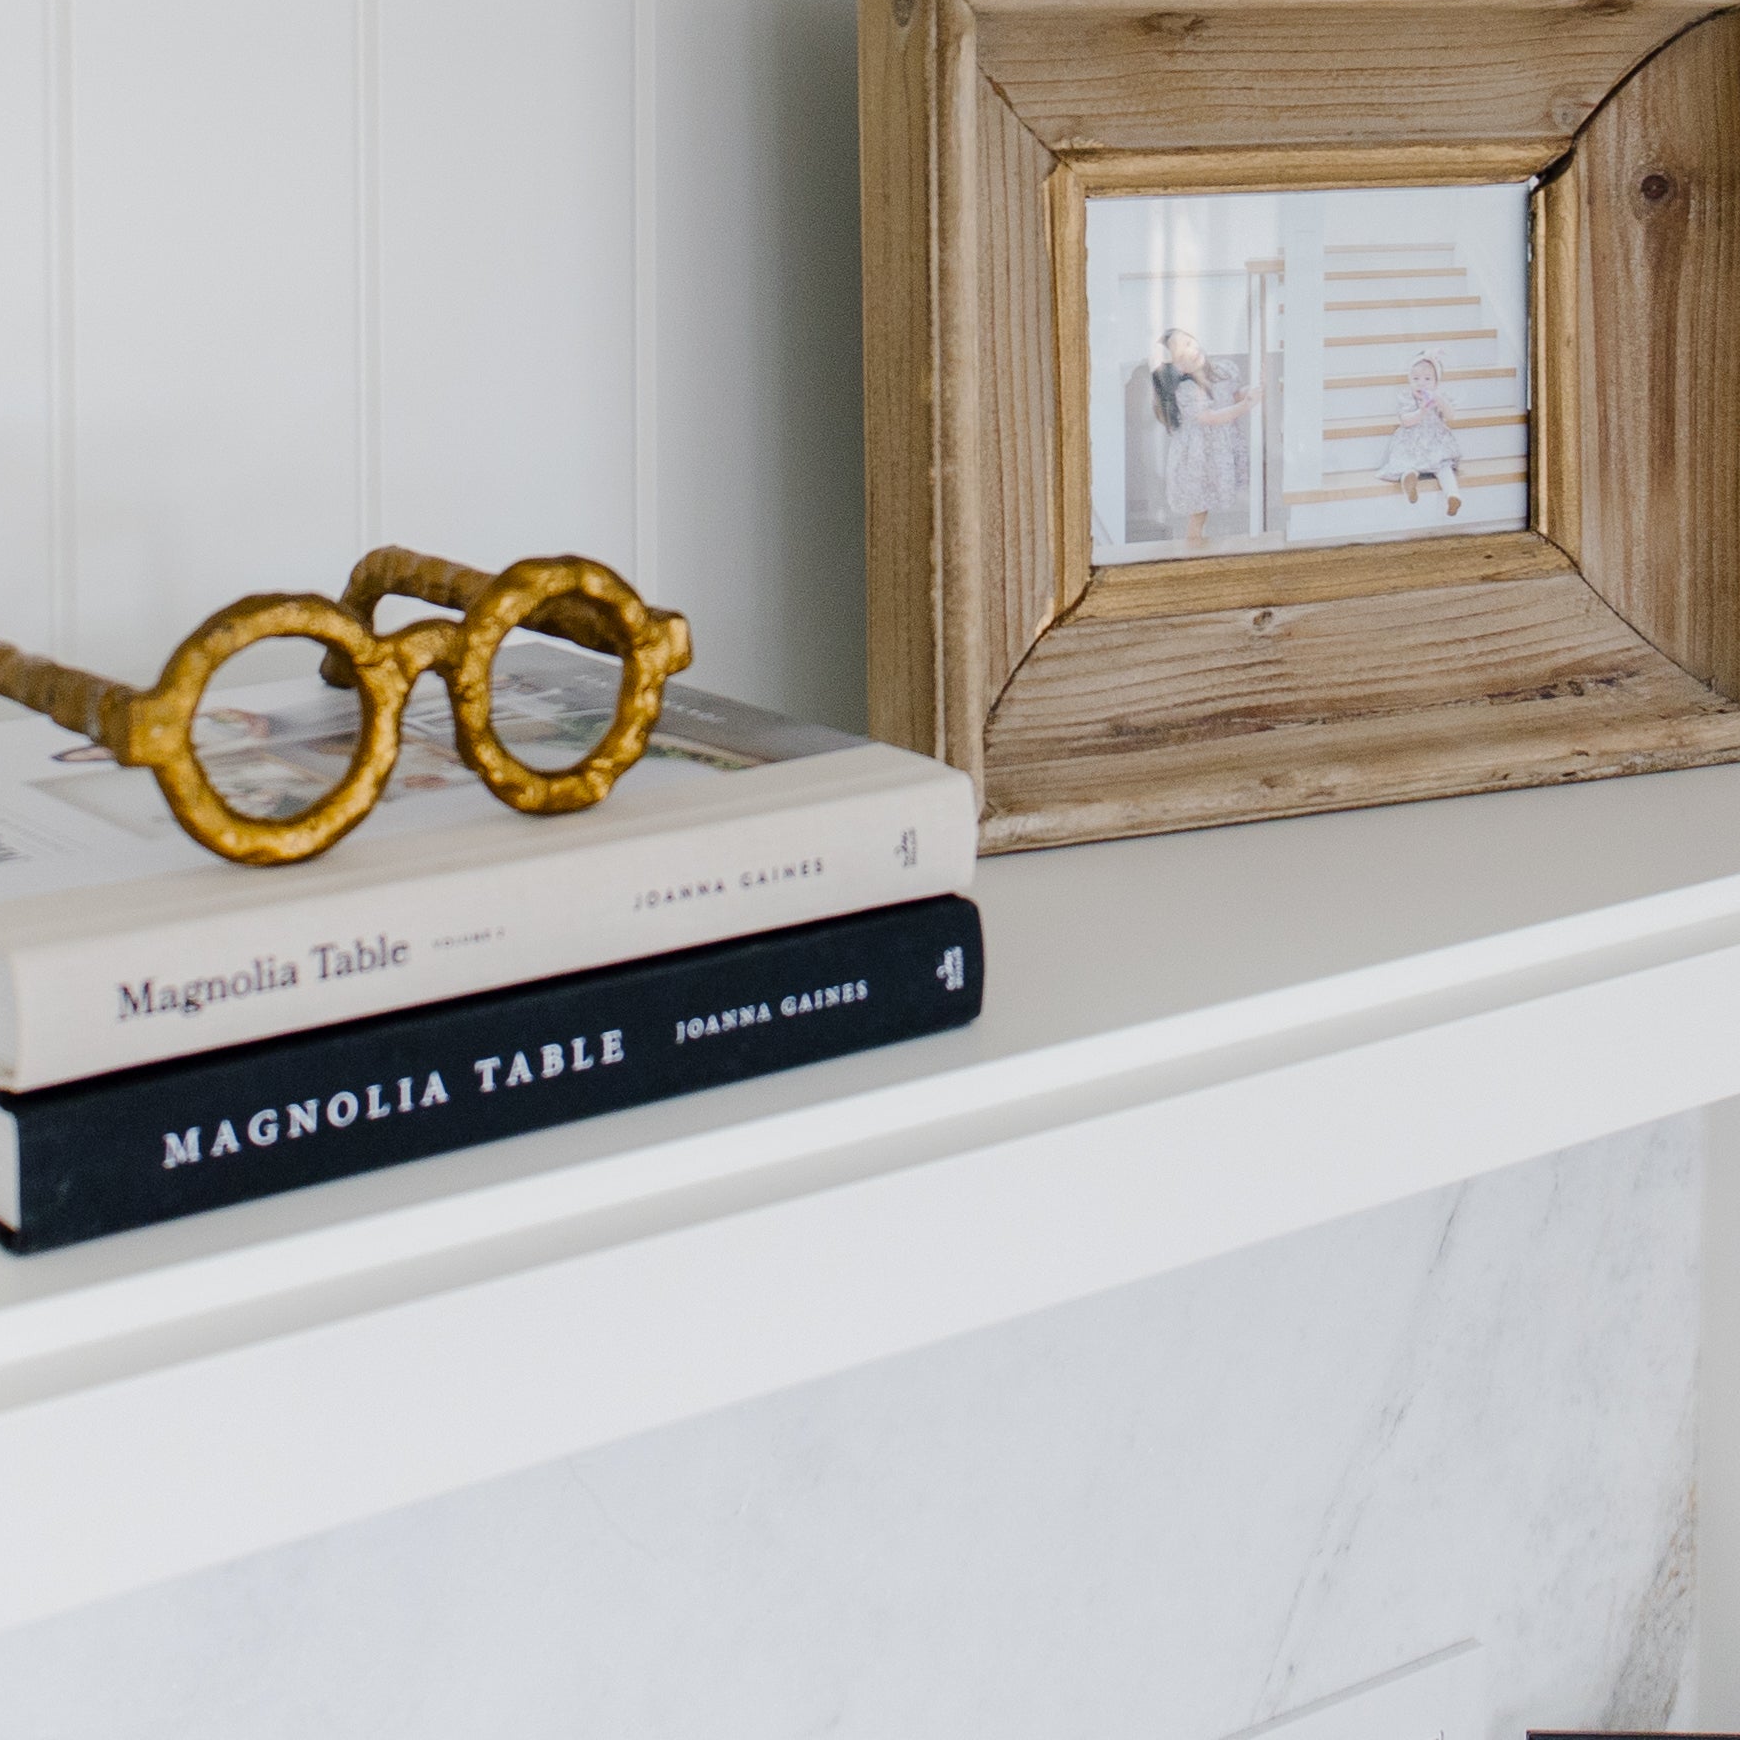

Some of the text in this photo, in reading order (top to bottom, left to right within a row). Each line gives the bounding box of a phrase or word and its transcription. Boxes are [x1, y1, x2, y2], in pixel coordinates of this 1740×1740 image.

[632, 856, 826, 911] JOANNA GAINES
[117, 931, 410, 1020] Magnolia Table
[674, 978, 870, 1045] JOANNA GAINES
[161, 1028, 626, 1170] MAGNOLIA TABLE
